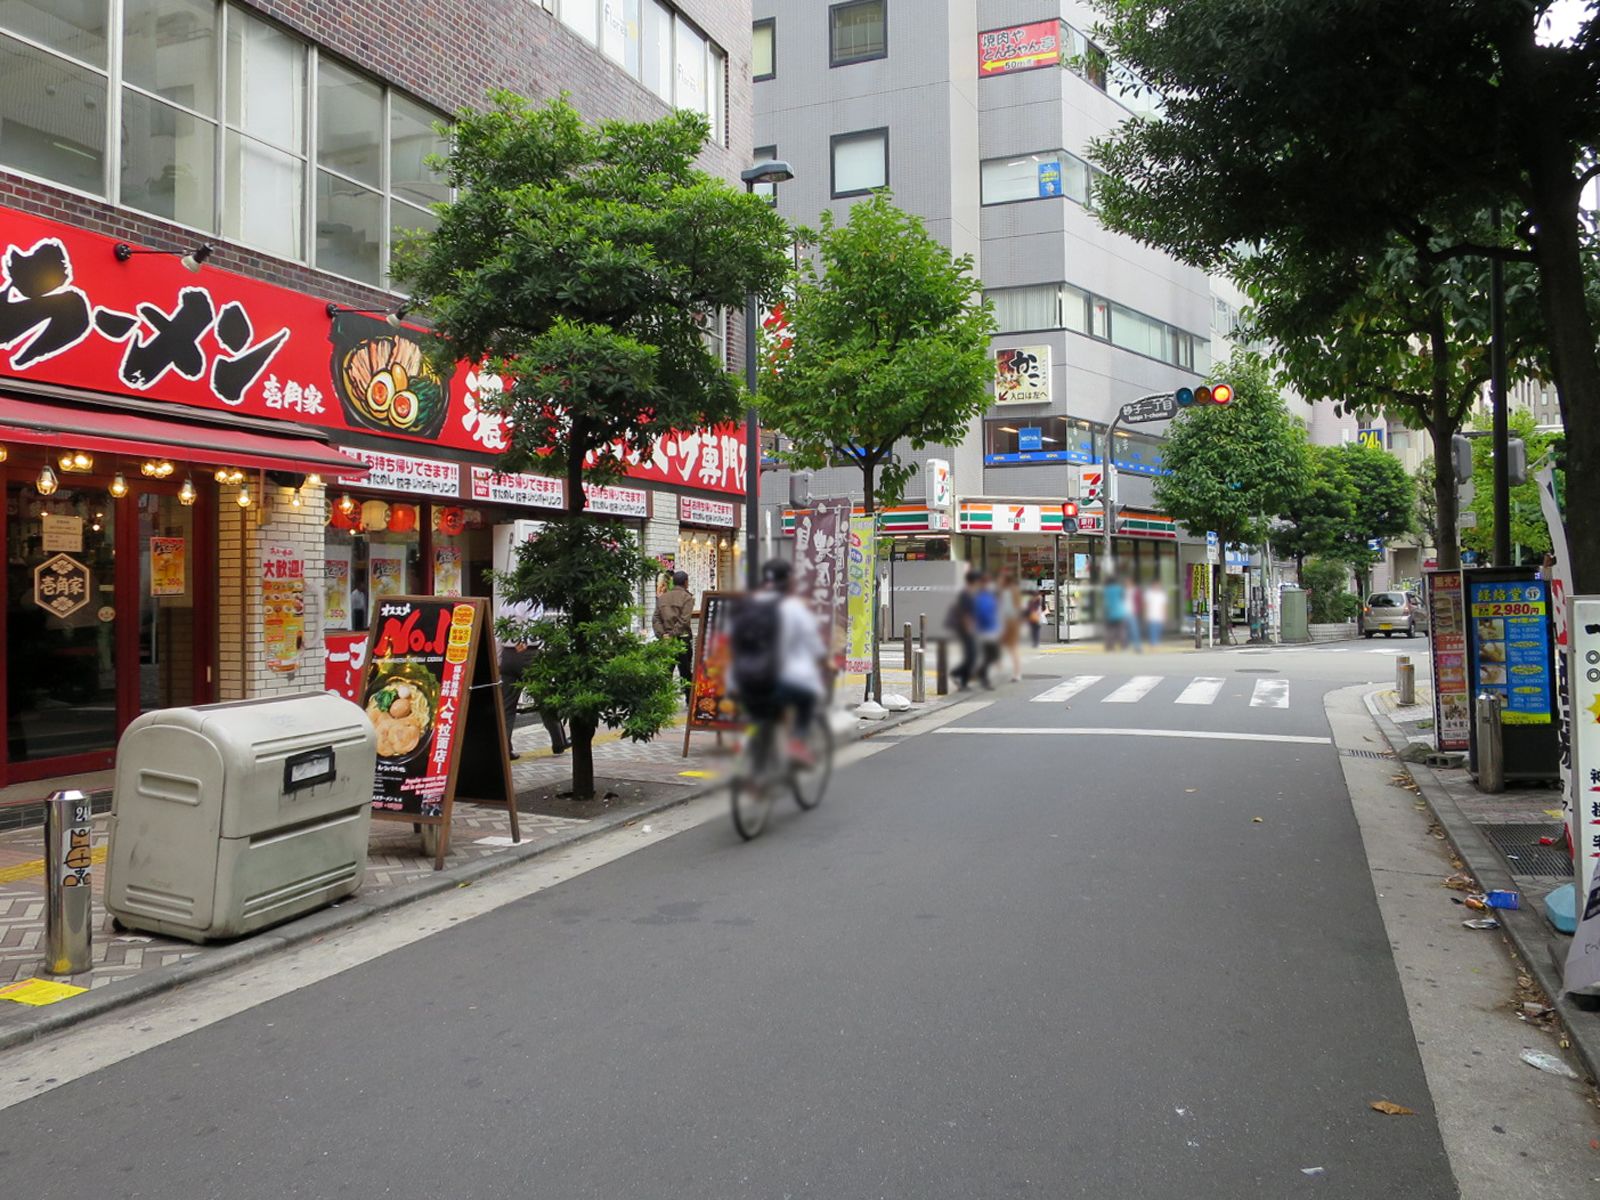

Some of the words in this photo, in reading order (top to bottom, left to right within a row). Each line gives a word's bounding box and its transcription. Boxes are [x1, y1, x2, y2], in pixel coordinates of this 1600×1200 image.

[262, 373, 326, 415] 壱角家
[263, 559, 304, 578] 大歓迎!
[41, 576, 84, 596] 壱角家
[381, 603, 411, 617] オススメ
[373, 608, 451, 657] No.1
